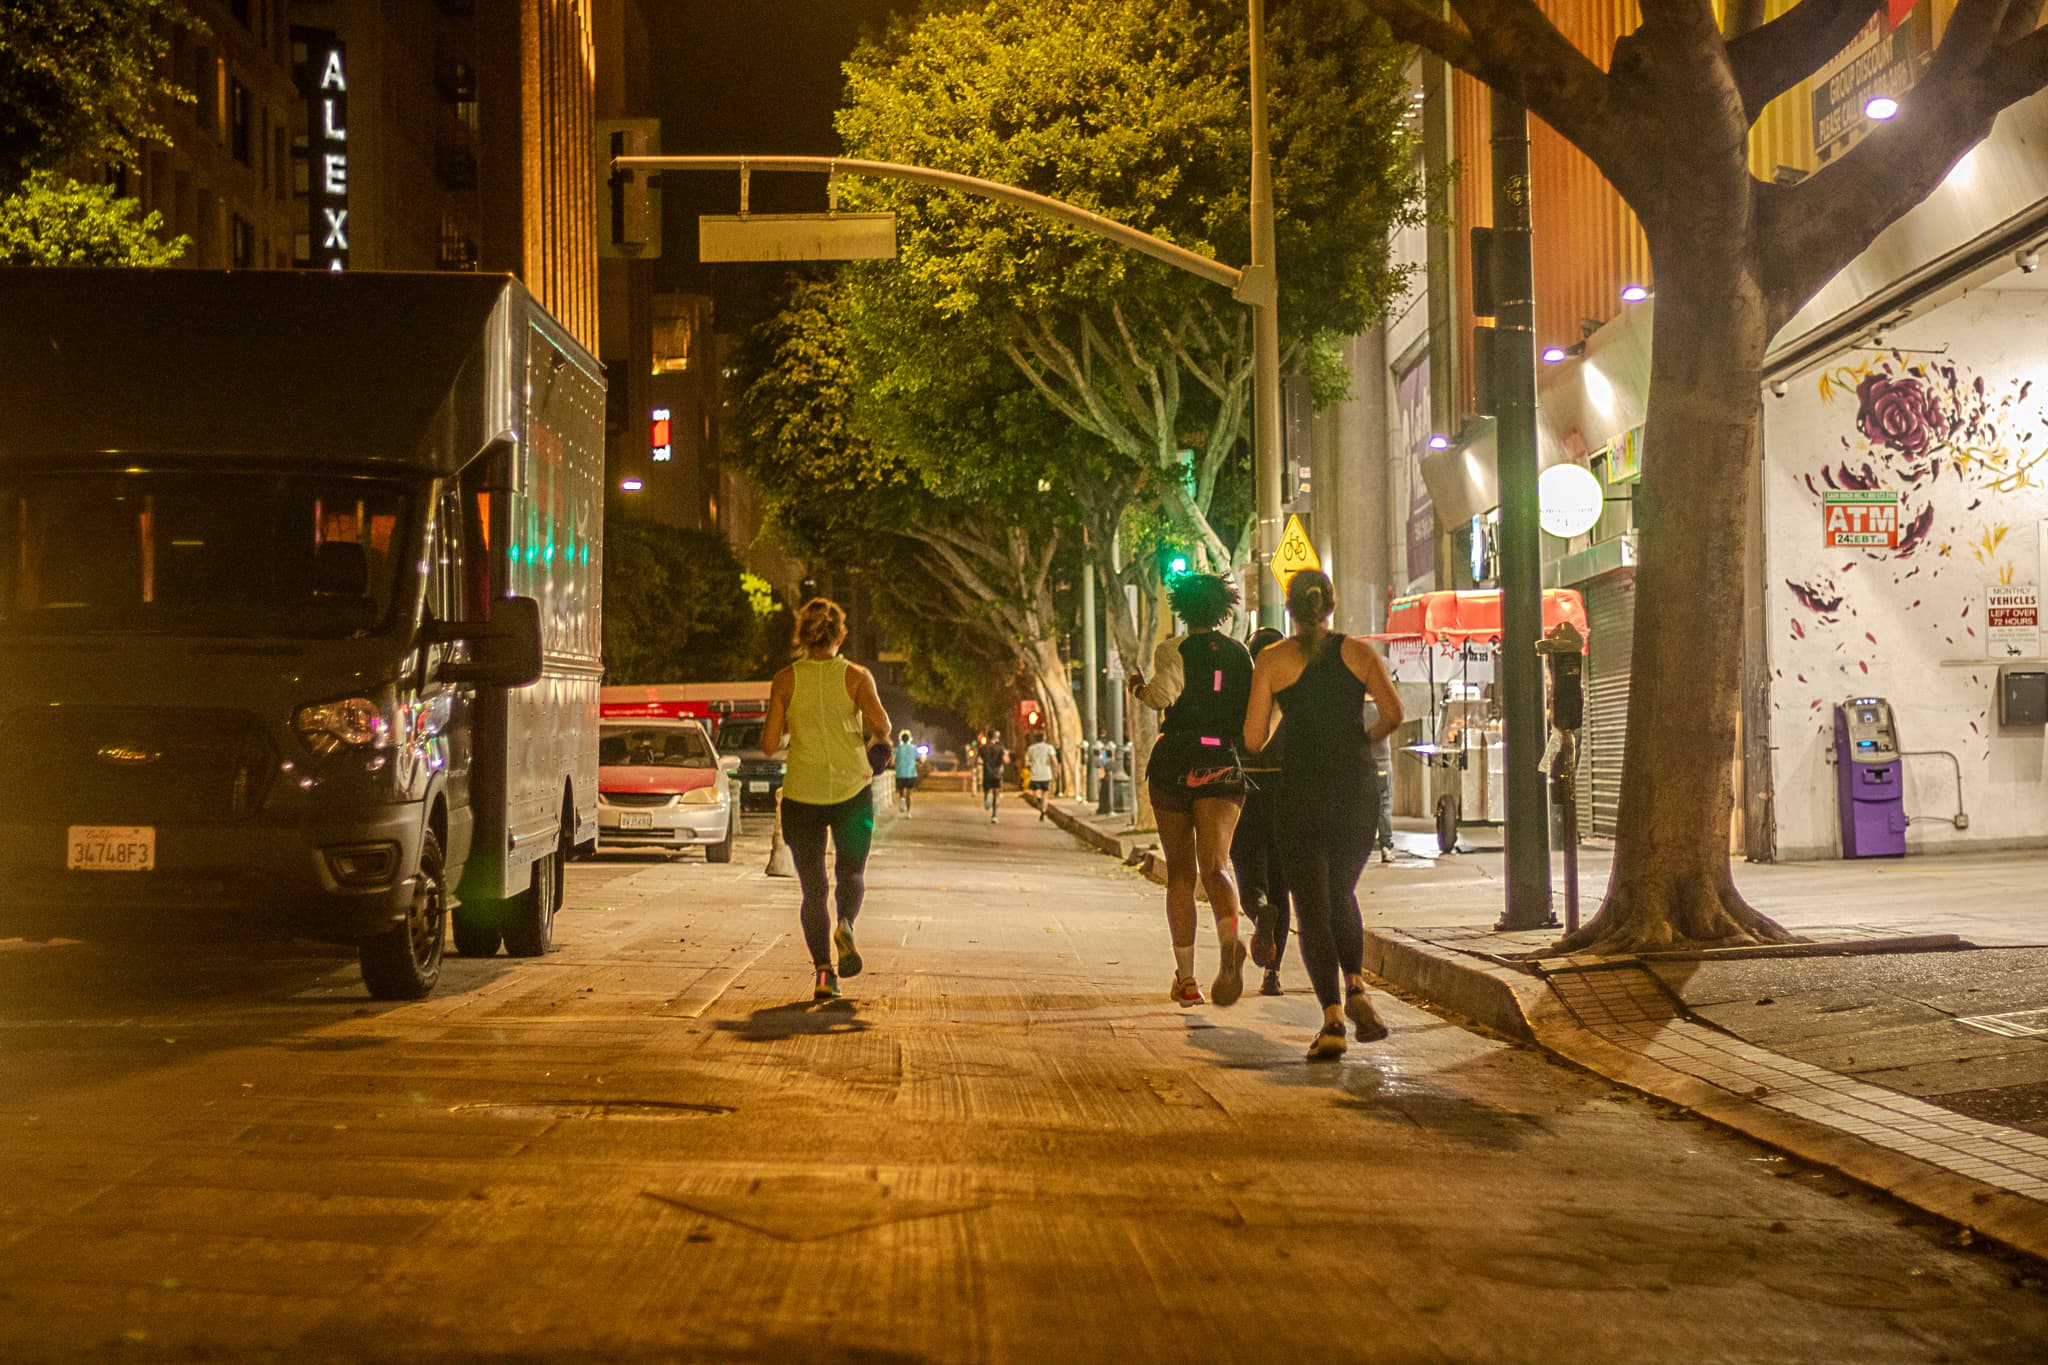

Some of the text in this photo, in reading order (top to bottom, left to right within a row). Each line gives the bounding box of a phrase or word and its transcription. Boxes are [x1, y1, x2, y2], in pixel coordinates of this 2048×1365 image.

[1830, 61, 1856, 105] GROUP
[1855, 33, 1894, 86] DISCOUNT
[1819, 106, 1841, 144] PLEASE
[1828, 507, 1895, 532] ATM
[1837, 534, 1850, 543] 24
[1854, 535, 1877, 543] EBT
[1993, 587, 2031, 595] MONTHLY
[1989, 596, 2036, 606] VEHICLES
[1990, 608, 2035, 617] LEFT OVER
[74, 843, 148, 863] 34748F3
